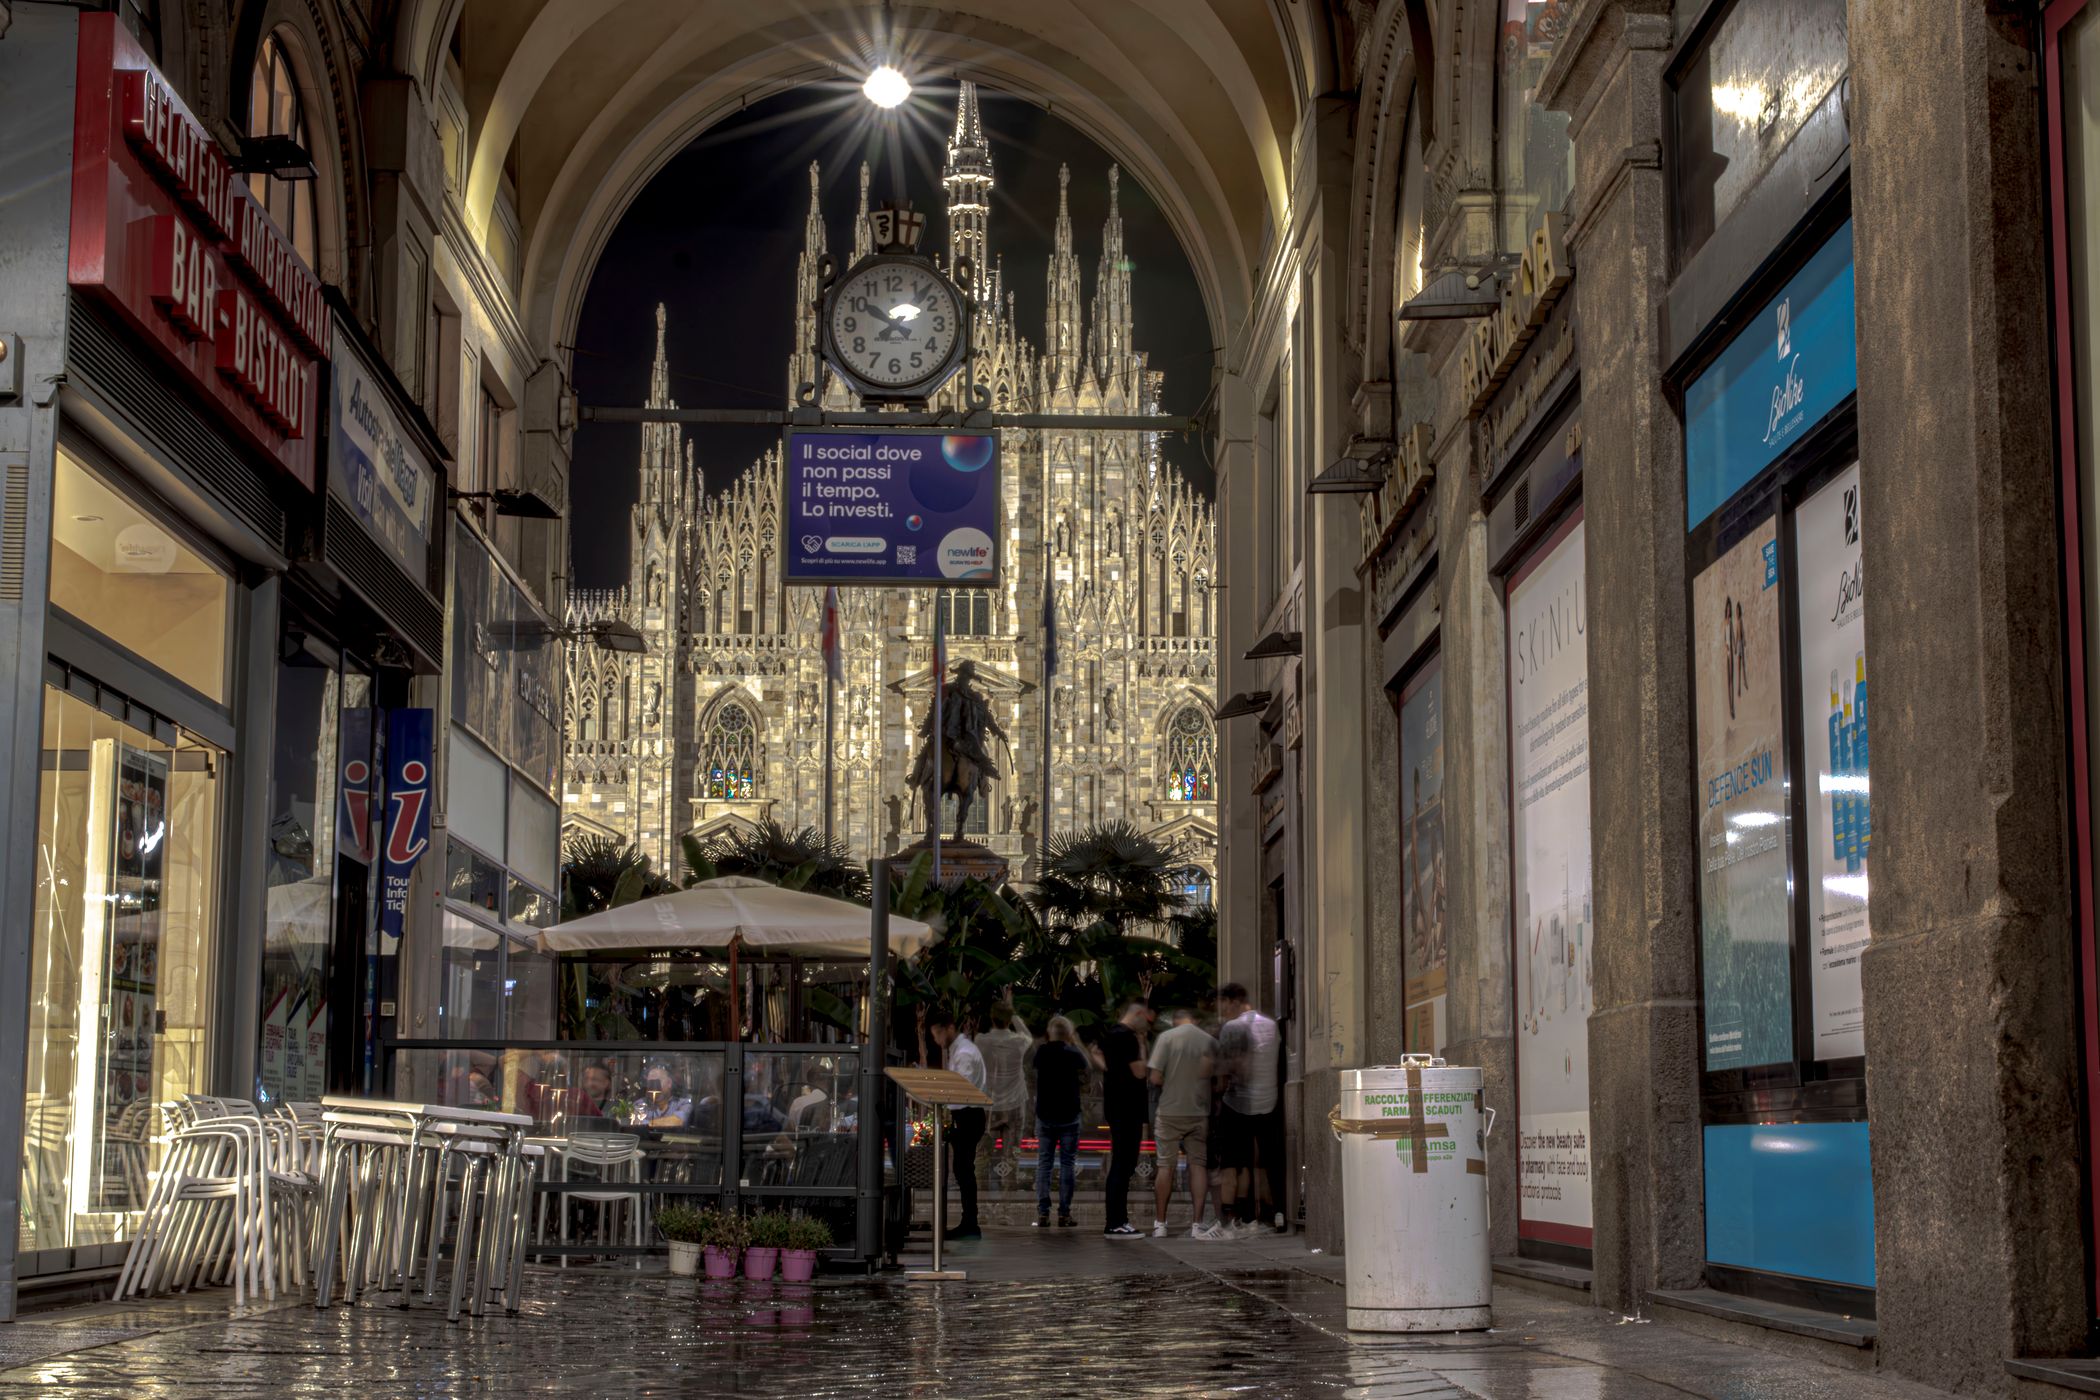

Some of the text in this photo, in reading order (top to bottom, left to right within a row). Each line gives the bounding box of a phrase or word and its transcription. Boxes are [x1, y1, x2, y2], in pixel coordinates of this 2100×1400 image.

[143, 69, 333, 361] GELATERIA AMBROSIANA
[863, 281, 879, 297] 11
[883, 276, 903, 292] 12
[910, 281, 918, 297] 1
[848, 296, 868, 313] 10
[926, 295, 938, 312] 2
[844, 316, 857, 333] 9
[932, 315, 945, 333] 3
[853, 336, 866, 354] 8
[924, 336, 938, 353] 4
[869, 352, 882, 369] 7
[888, 358, 901, 375] 6
[909, 352, 922, 369] 5
[803, 444, 922, 461] Il social dove
[803, 464, 892, 482] non passi
[802, 482, 880, 501] il tempo.
[802, 501, 894, 518] Lo investi.
[801, 557, 818, 566] Scopri
[1707, 750, 1772, 808] DEFENCE SUN
[1364, 1094, 1412, 1105] RACCOLTA
[1425, 1105, 1462, 1115] SCADUTI
[1537, 1128, 1545, 1149] the
[1546, 1134, 1556, 1149] new
[1556, 1127, 1573, 1155] beauty
